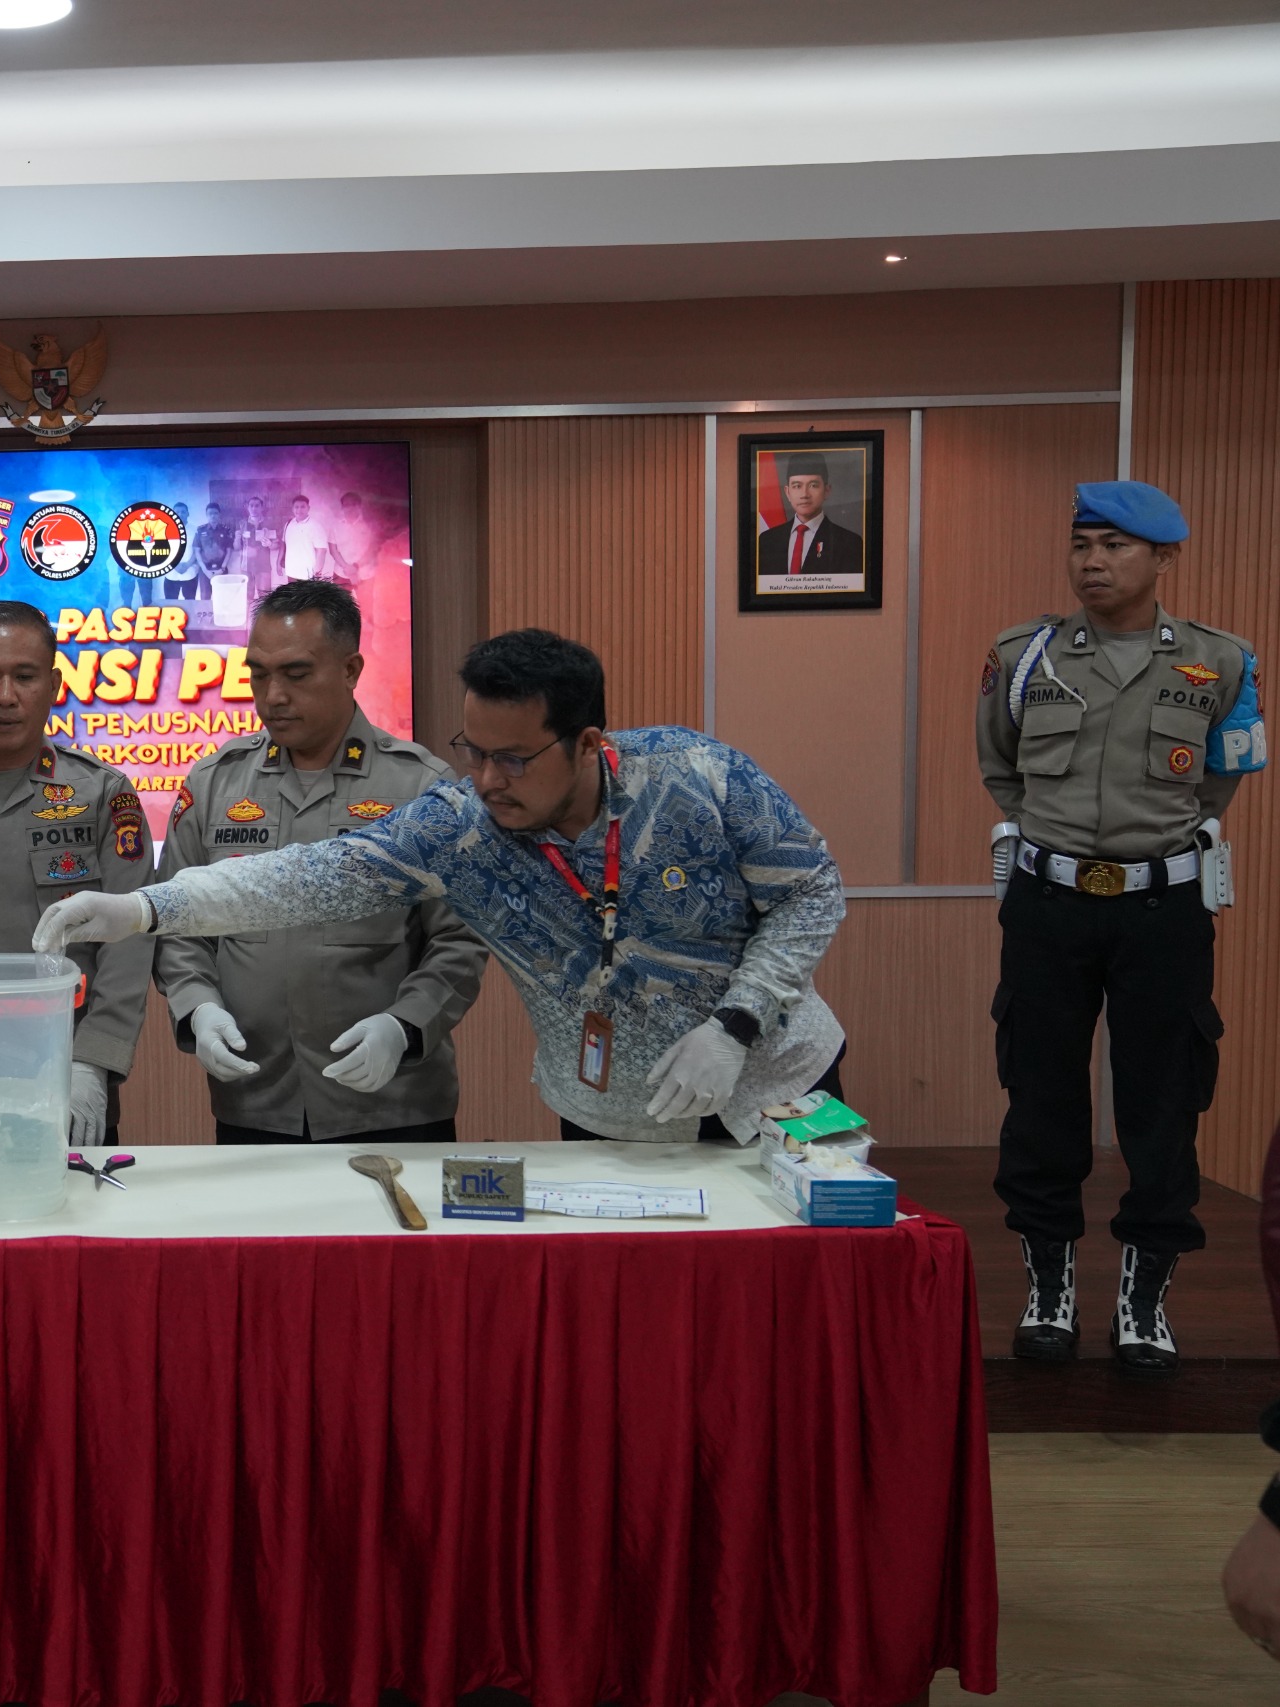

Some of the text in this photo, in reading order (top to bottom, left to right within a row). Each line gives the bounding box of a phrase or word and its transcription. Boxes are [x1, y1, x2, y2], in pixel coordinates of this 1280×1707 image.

[28, 505, 96, 556] SATUAN RESERSE NARKOBA
[160, 505, 186, 545] DIPERCAYA
[151, 548, 170, 556] POLRI
[40, 567, 80, 579] POLRES PASER
[124, 564, 173, 578] PARTISIPASI
[56, 606, 188, 643] PASER
[1158, 688, 1216, 712] POLRI
[32, 825, 92, 847] POLRI
[214, 827, 270, 845] HENDRO
[461, 1168, 505, 1195] nik
